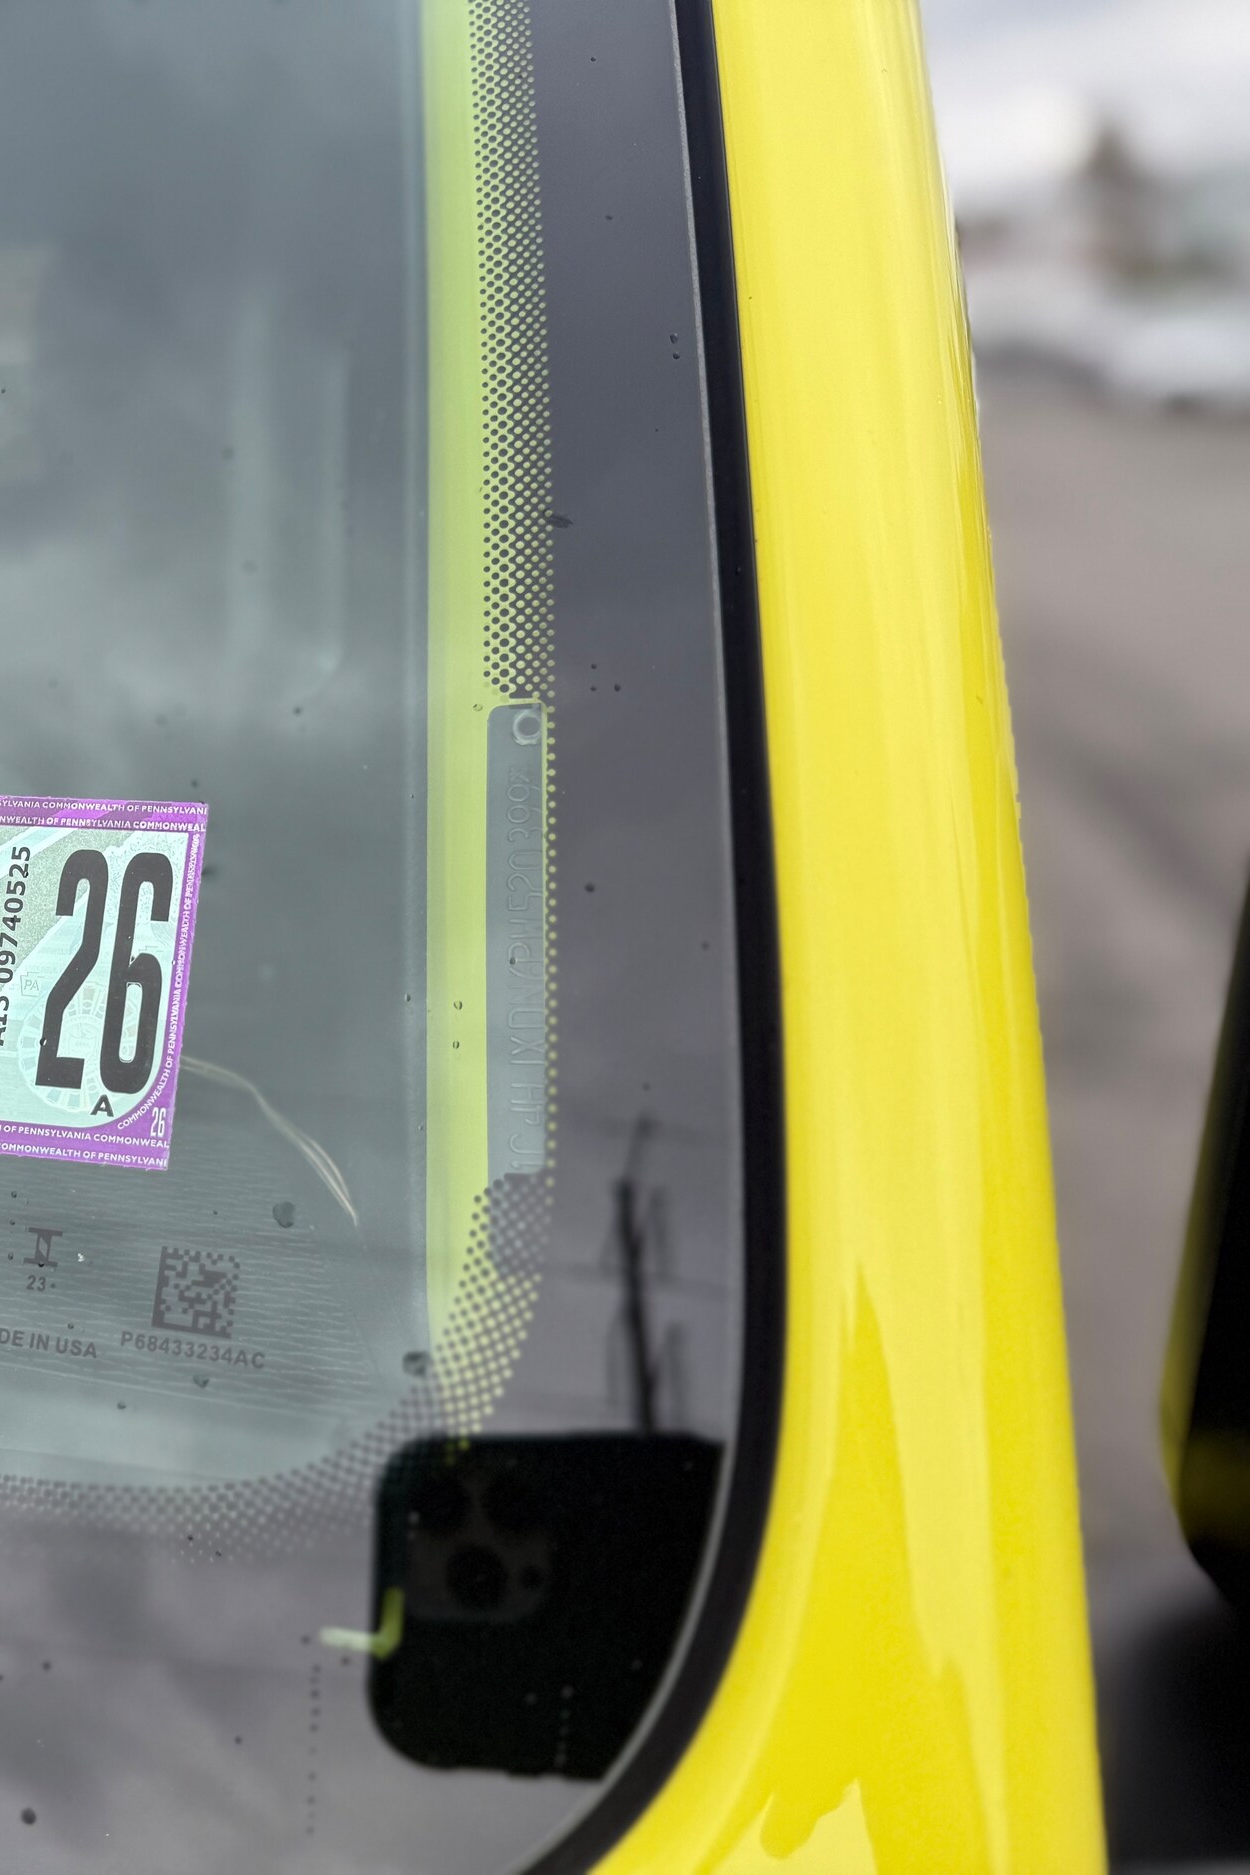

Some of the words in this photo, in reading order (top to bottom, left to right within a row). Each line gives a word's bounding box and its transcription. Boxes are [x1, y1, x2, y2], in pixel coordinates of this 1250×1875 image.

[42, 801, 126, 812] COMMONWEALTH
[126, 804, 140, 812] OF
[46, 816, 60, 826] OF
[60, 818, 131, 829] PENNSYLVANIA
[132, 821, 207, 832] COMMONWEAL
[35, 849, 174, 1095] 26
[168, 989, 182, 1055] PENNSYLVANIA
[165, 1054, 175, 1070] OF
[90, 1094, 114, 1118] A
[117, 1071, 171, 1130] COMMONWEALTH
[150, 1107, 166, 1138] 26
[3, 1125, 18, 1134] OF
[18, 1126, 92, 1141] PENNSYLVANIA
[94, 1133, 170, 1148] COMMONWEAL
[82, 1150, 97, 1159] OF
[29, 1332, 51, 1351] IN
[56, 1336, 98, 1360] USA
[120, 1330, 266, 1370] P68433234AC
